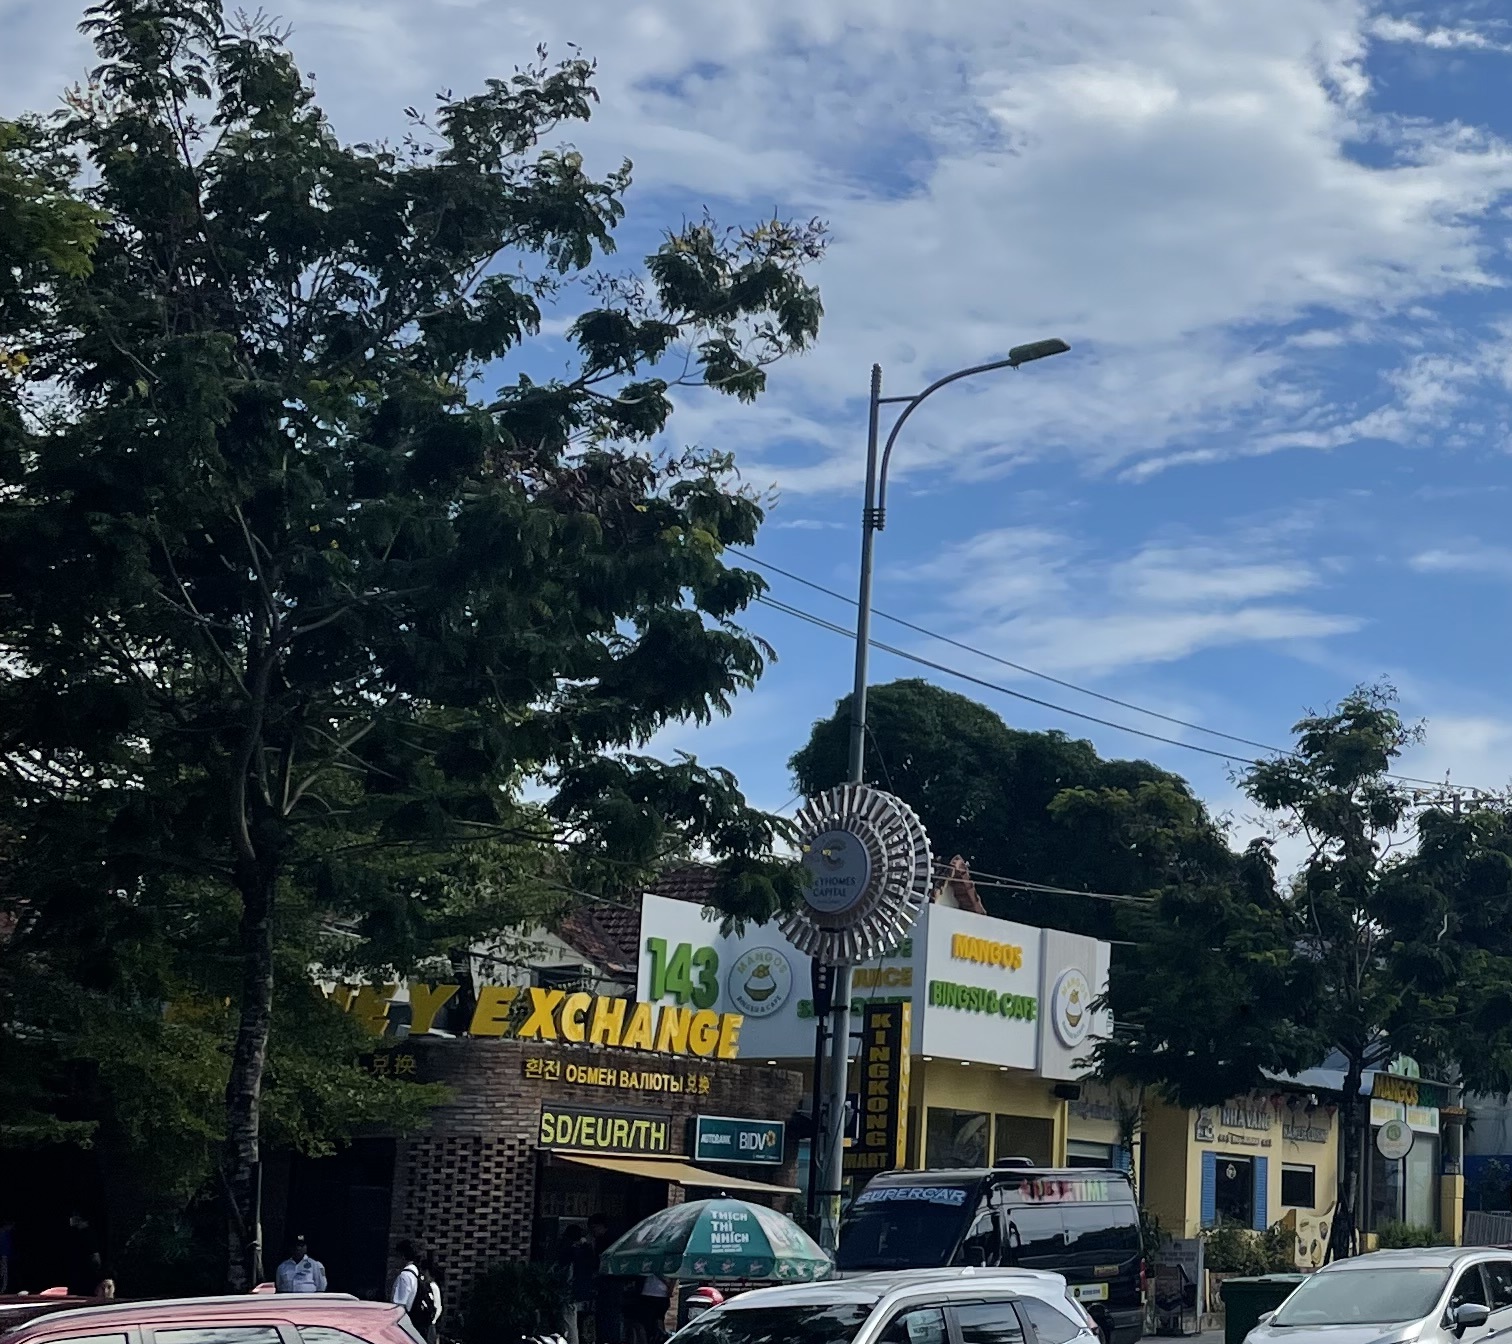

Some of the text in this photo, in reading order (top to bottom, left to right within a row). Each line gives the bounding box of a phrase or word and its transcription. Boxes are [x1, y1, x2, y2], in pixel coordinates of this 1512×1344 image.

[737, 952, 788, 974] MANGOS
[951, 933, 1023, 971] MANGOS
[648, 937, 719, 1009] 143
[469, 986, 744, 1059] EXCHANGE
[524, 1057, 561, 1081] 환전
[566, 1066, 684, 1094] ОБМЕН ВАЛЮТЫ
[865, 1013, 893, 1147] KINGKONG
[541, 1112, 667, 1151] SD/EUR/TH
[740, 1131, 767, 1151] BIDV
[856, 1187, 967, 1206] SUPERCAR
